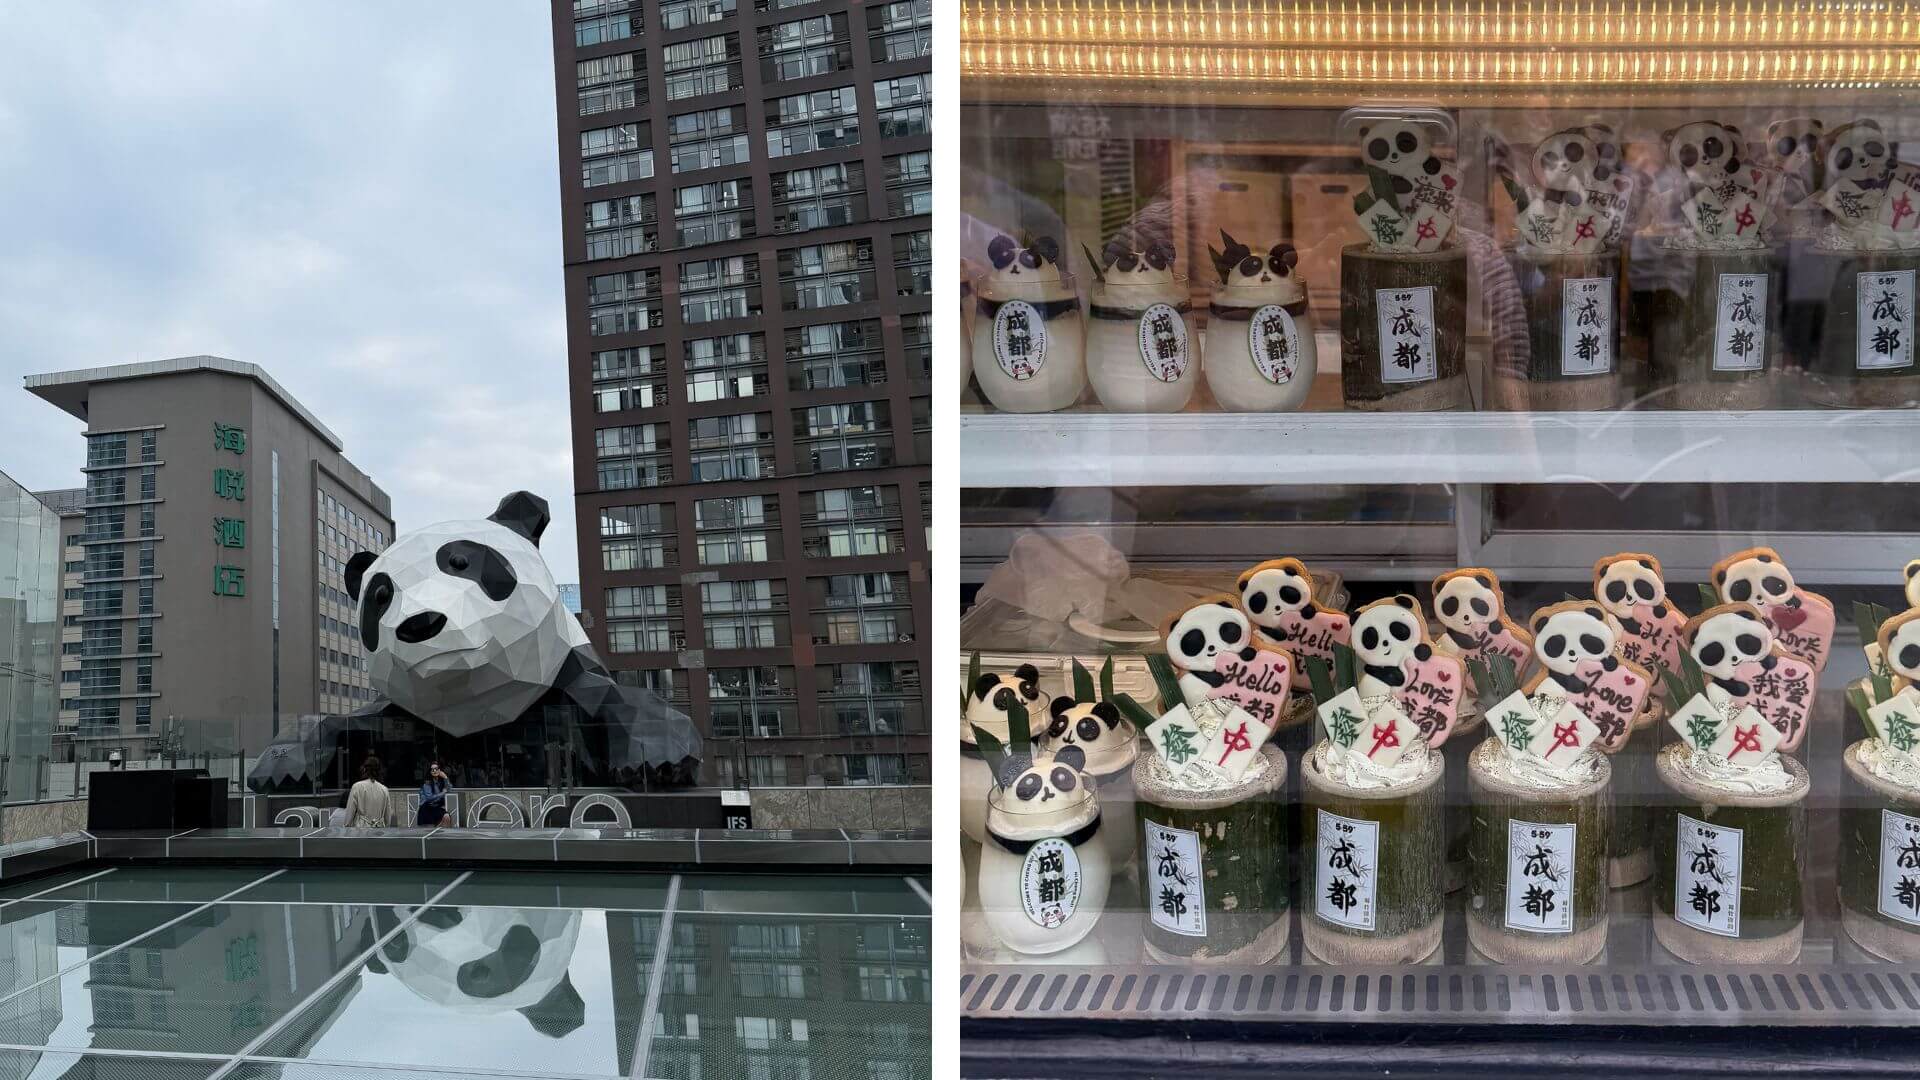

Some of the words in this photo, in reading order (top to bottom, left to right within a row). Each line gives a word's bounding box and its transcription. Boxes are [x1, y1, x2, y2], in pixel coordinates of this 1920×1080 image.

[1007, 310, 1031, 357] 成都
[1152, 313, 1177, 360] 成都
[1262, 314, 1288, 361] 成都
[1391, 306, 1421, 374] 成都
[1573, 297, 1601, 366] 成都
[1727, 293, 1756, 362] 成都
[1869, 290, 1902, 360] 成都
[213, 421, 246, 597] 海悦酒店
[1288, 622, 1334, 651] Hell
[1222, 662, 1282, 695] Hello
[1584, 670, 1633, 713] Love
[1752, 669, 1810, 709] 我愛
[726, 816, 748, 829] IFS
[1038, 850, 1065, 903] 成都
[1158, 846, 1187, 926] 成都
[1325, 838, 1361, 918] 成都
[1519, 844, 1558, 925] 成都
[1686, 843, 1724, 923] 成都
